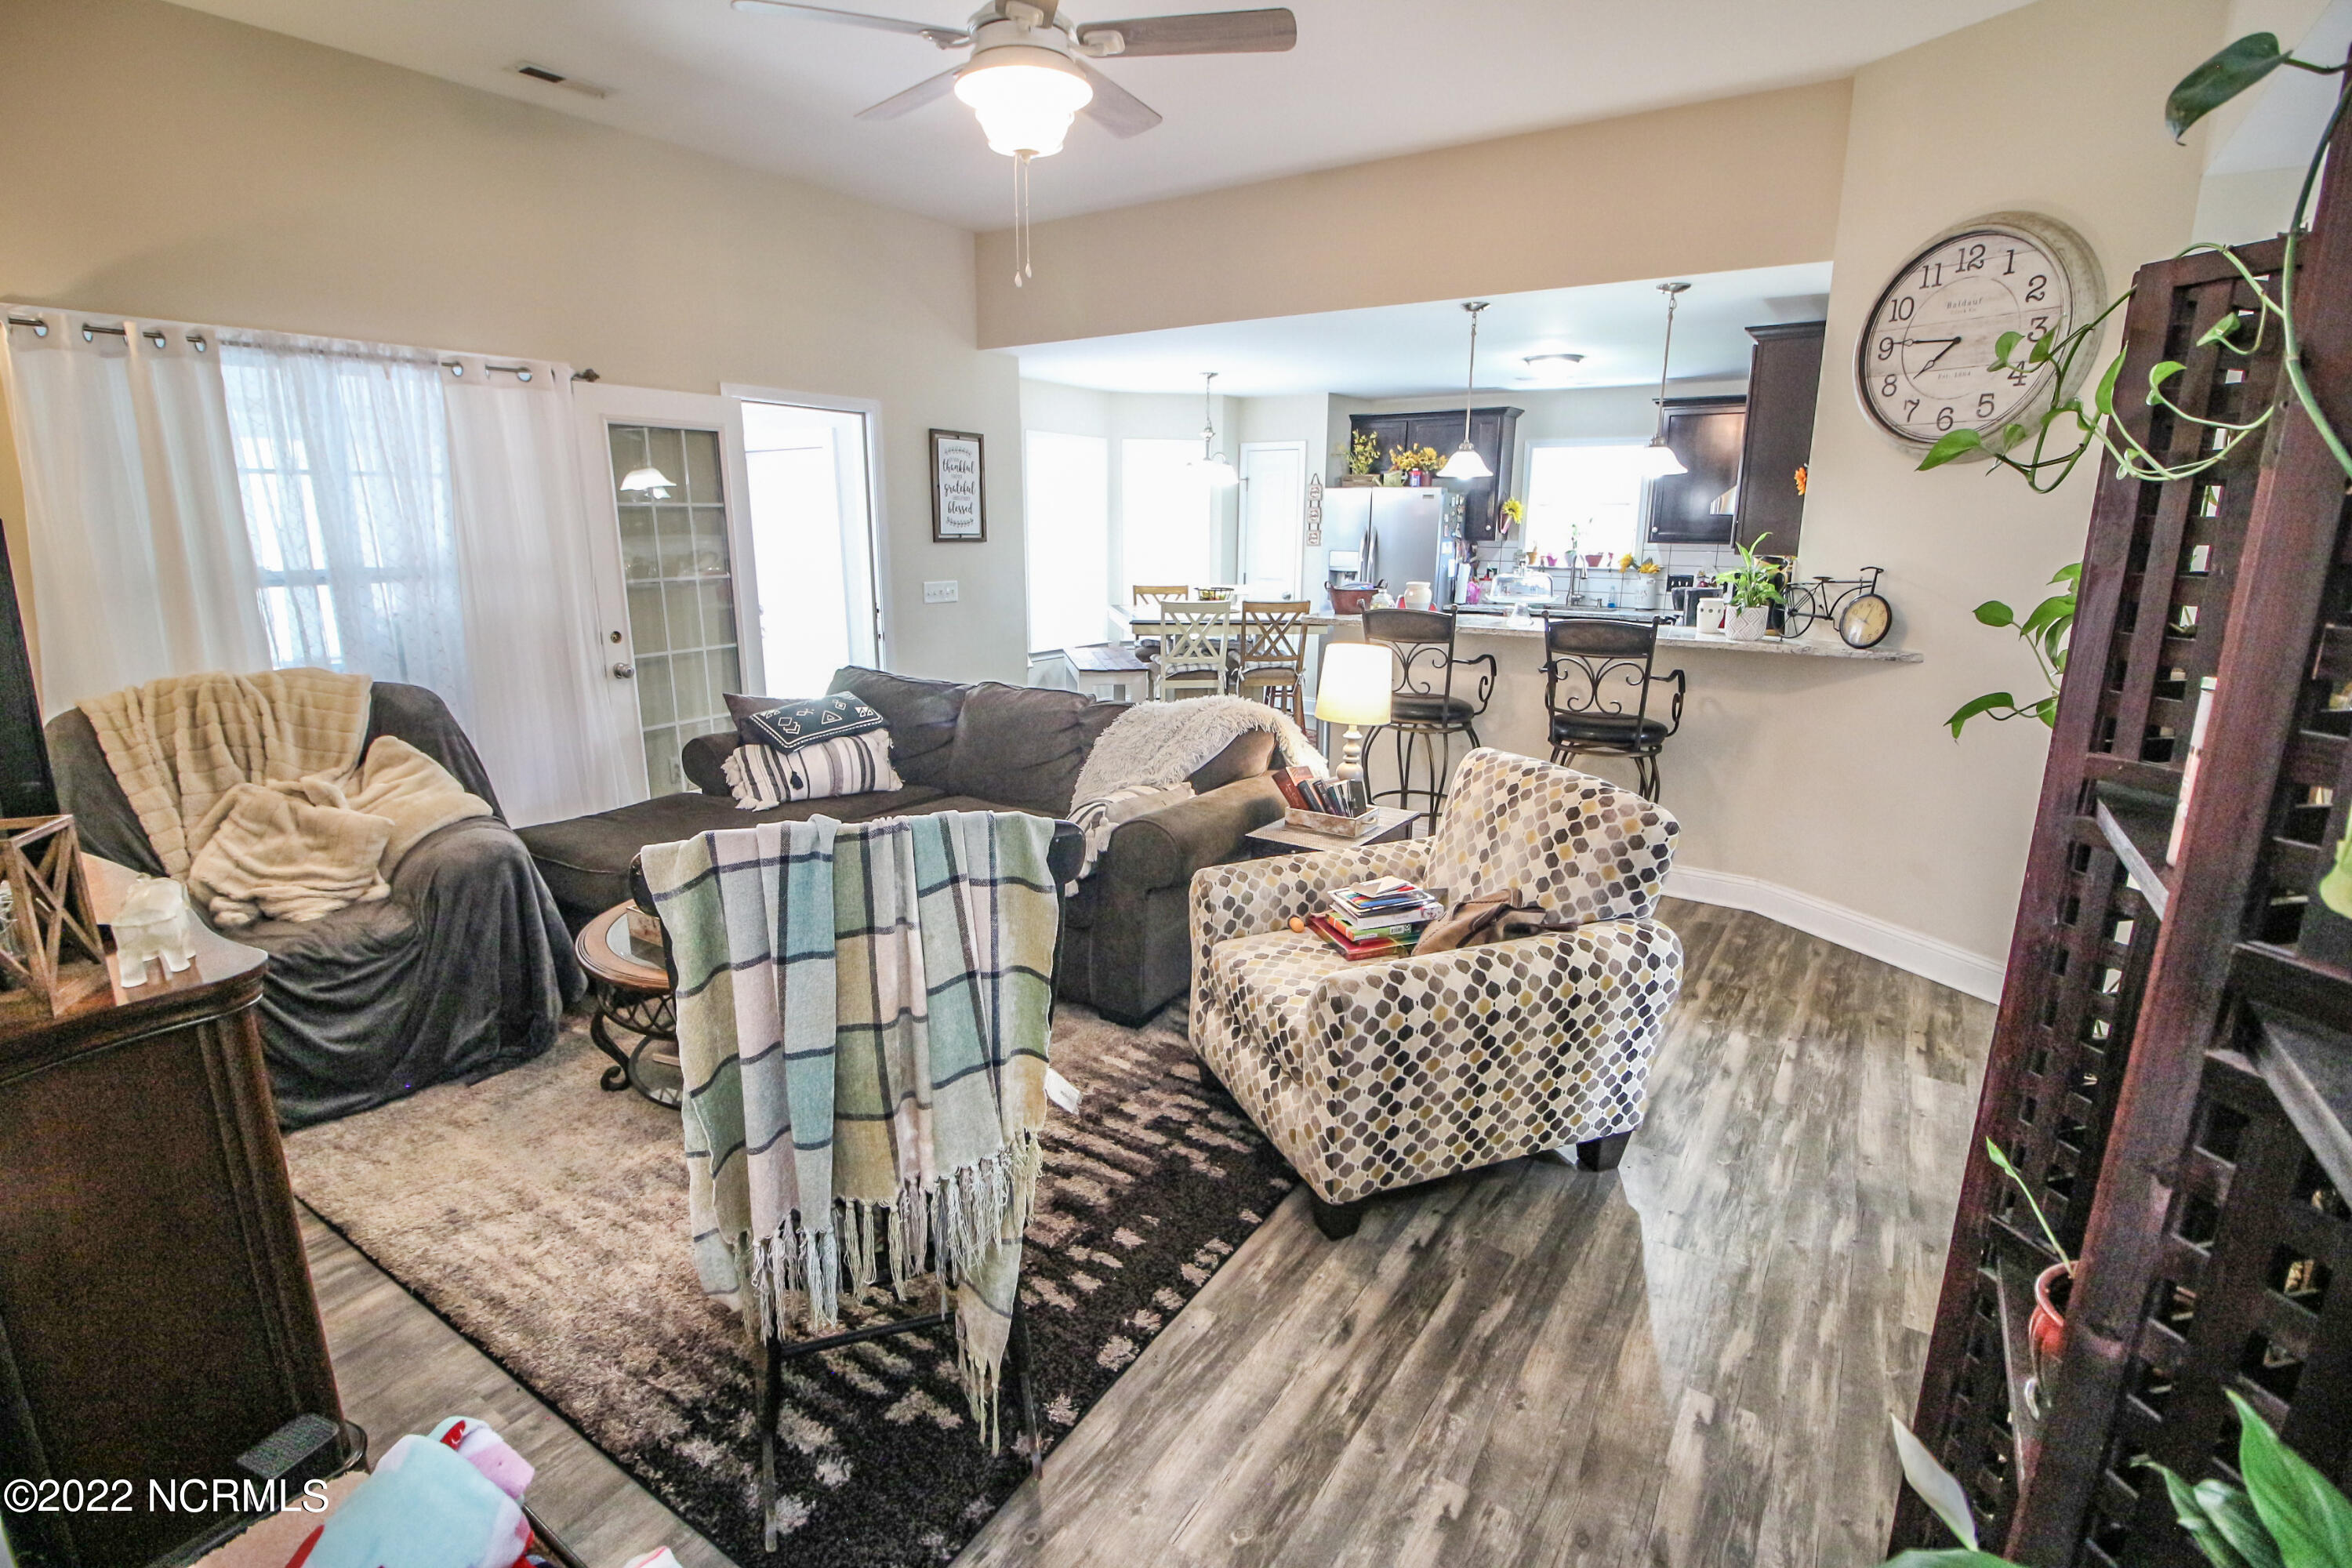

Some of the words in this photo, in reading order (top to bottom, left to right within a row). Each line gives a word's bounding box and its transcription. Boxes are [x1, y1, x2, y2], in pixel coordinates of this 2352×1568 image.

[1955, 244, 1986, 273] 12
[2002, 249, 2016, 275] 1
[1919, 263, 1943, 289] 11
[2025, 275, 2047, 303] 2
[1888, 296, 1915, 322] 10
[2027, 317, 2049, 343] 3
[1878, 337, 1895, 361] 9
[1882, 374, 1897, 397] 8
[2007, 361, 2027, 387] 4
[1904, 399, 1920, 423] 7
[1976, 394, 1994, 418] 5
[1936, 407, 1954, 431] 6
[942, 458, 975, 474] thankful
[944, 480, 975, 497] grateful
[947, 500, 973, 515] blessed
